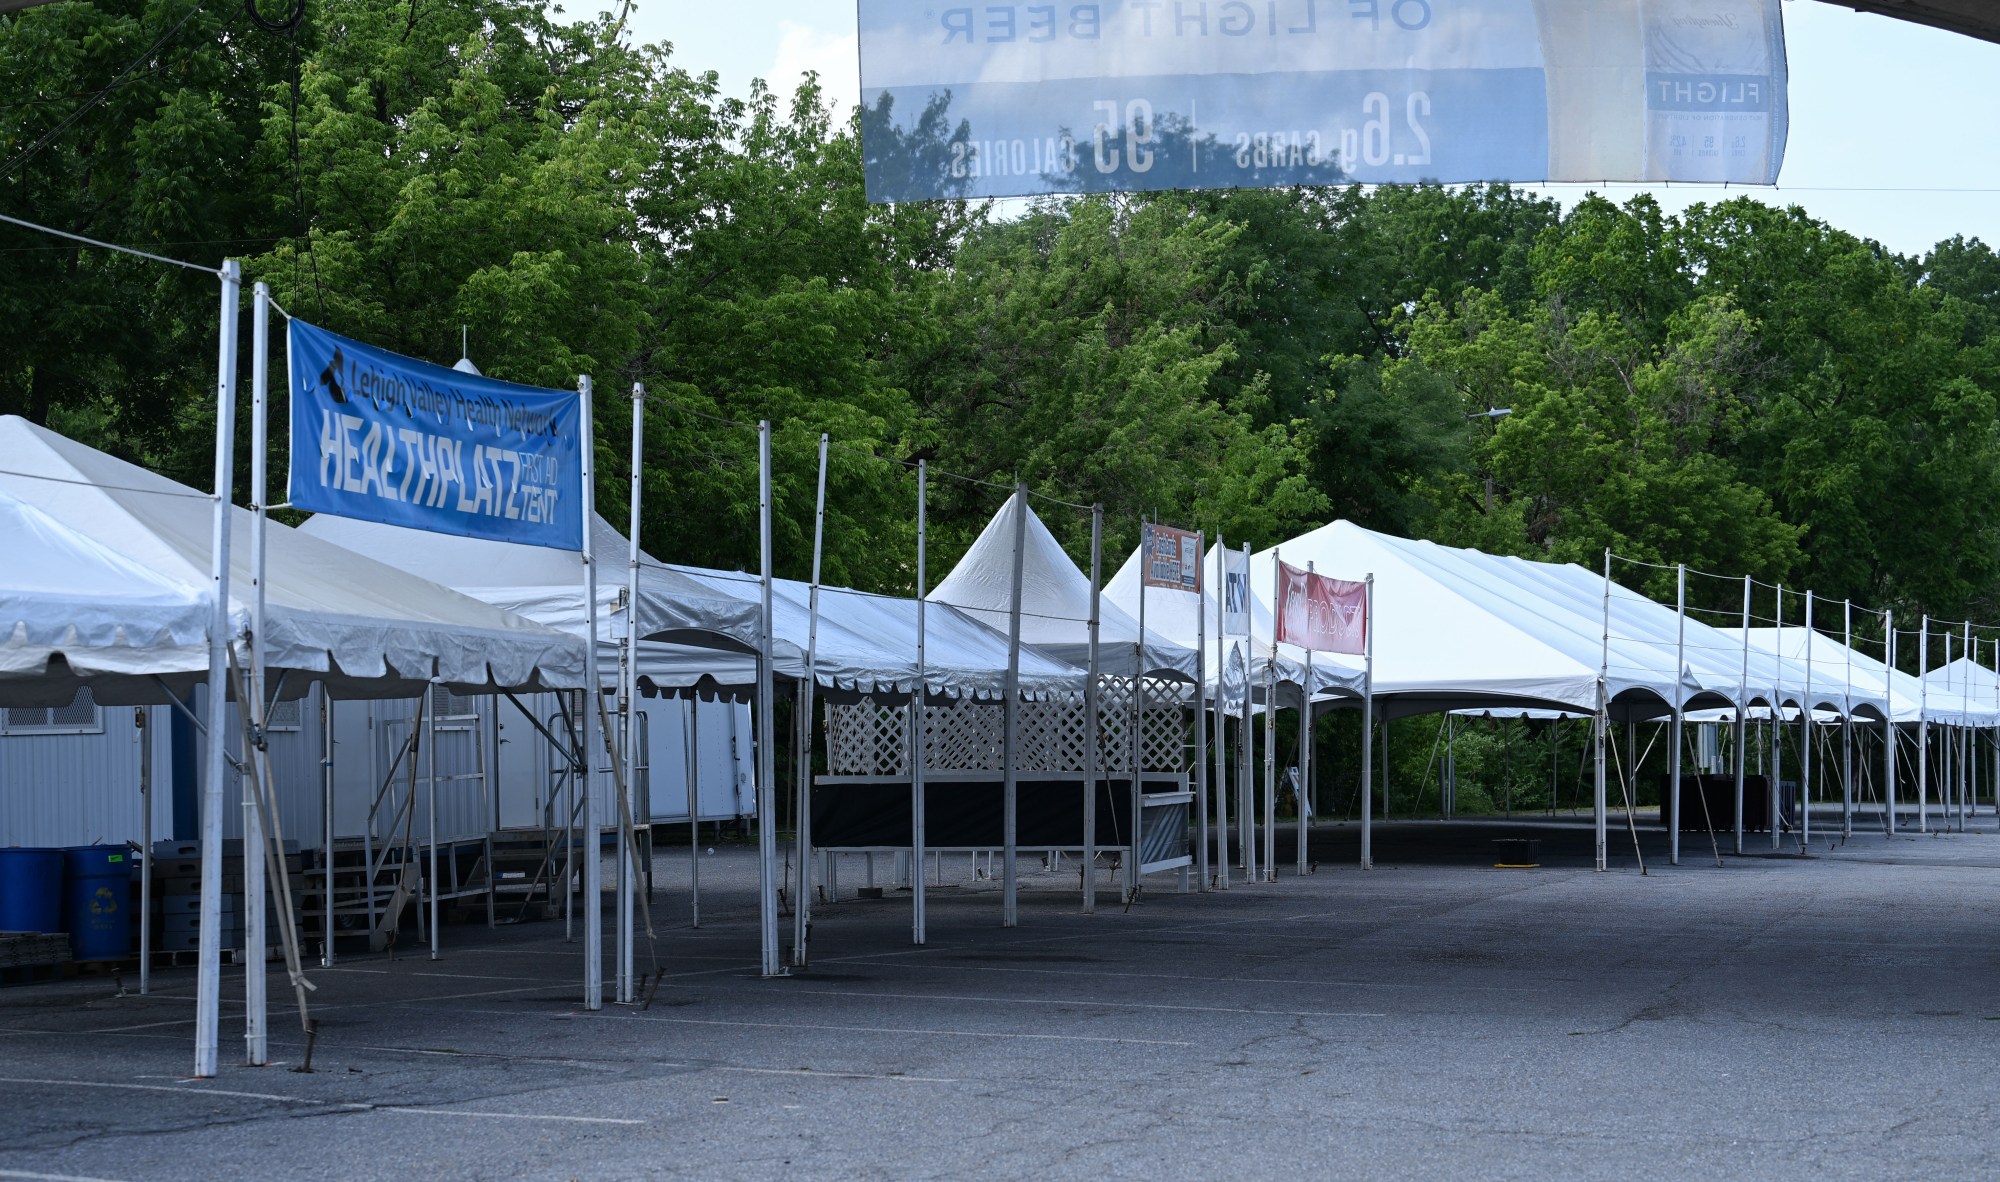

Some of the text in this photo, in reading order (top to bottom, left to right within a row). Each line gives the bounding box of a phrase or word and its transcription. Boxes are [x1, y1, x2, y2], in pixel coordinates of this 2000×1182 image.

[351, 359, 558, 446] Lehigh Valley Health Network
[320, 408, 521, 520] HEALTHPLATZ
[519, 451, 558, 486] FIRST AID
[520, 484, 558, 525] TENT
